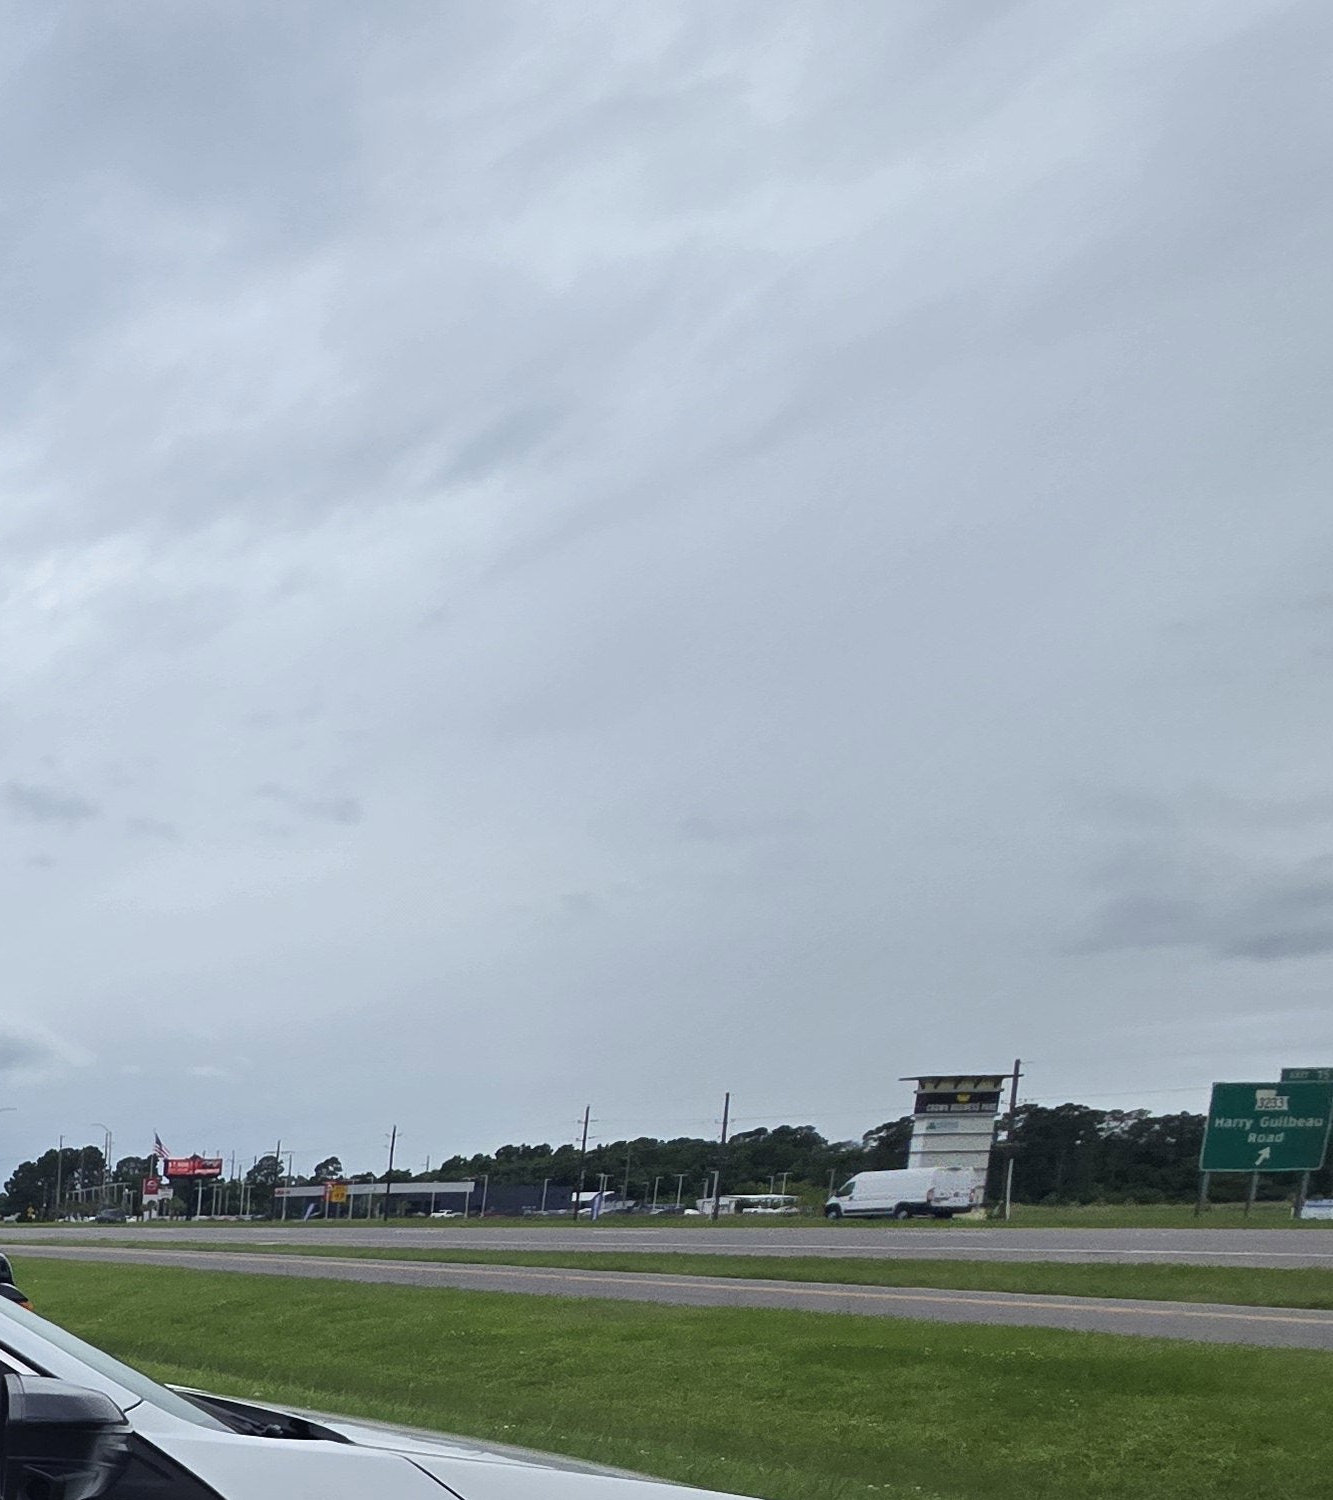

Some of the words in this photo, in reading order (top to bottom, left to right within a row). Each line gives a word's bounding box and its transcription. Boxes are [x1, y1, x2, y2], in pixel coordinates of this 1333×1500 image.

[1214, 1117, 1254, 1131] Harry
[1259, 1116, 1324, 1128] Guilbeau
[1247, 1132, 1285, 1143] Road
